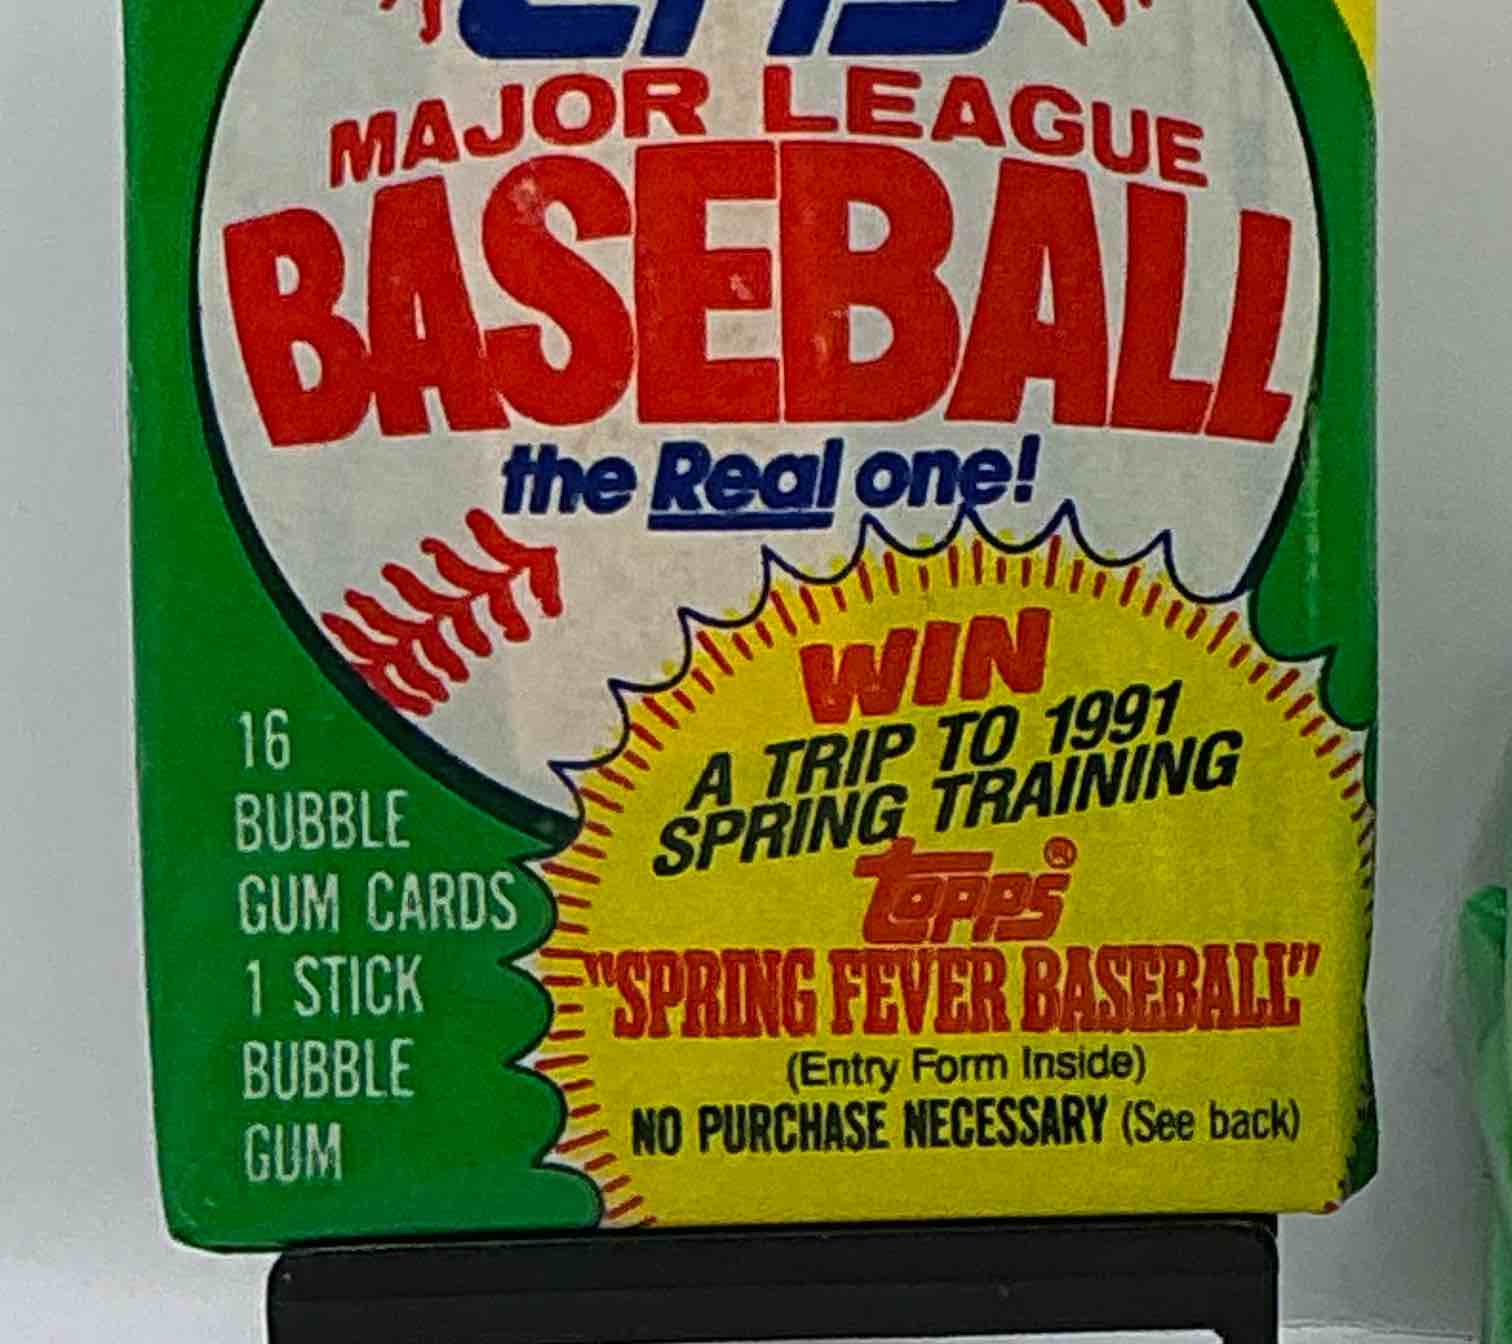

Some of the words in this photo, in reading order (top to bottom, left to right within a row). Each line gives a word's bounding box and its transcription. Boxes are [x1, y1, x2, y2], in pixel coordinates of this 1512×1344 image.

[330, 67, 710, 188] MAJOR
[762, 67, 1208, 188] LEAGUE
[222, 139, 1293, 447] BASEBALL
[502, 443, 637, 514] the
[648, 438, 844, 529] Real
[855, 434, 1040, 507] one!
[800, 607, 1051, 724] WIN
[238, 708, 291, 770] 16
[686, 753, 732, 811] A
[765, 723, 916, 799] TRIP
[939, 705, 1020, 772] TO
[1045, 679, 1184, 749] 1991
[234, 789, 411, 852] BUBBLE
[653, 785, 908, 877] SPRING
[934, 729, 1244, 833] TRAINING
[238, 873, 341, 935] GUM
[367, 870, 518, 932] CARDS
[245, 959, 263, 1017] 1
[293, 955, 425, 1017] STICK
[581, 947, 815, 1038] "SPRING
[828, 945, 1011, 1036] FEVER
[1021, 942, 1321, 1034] BASEBALL"
[242, 1038, 416, 1100] BUBBLE
[787, 1051, 899, 1094] (Entry
[913, 1049, 1009, 1086] Form
[1022, 1044, 1147, 1086] Inside)
[245, 1122, 344, 1185] GUM
[631, 1107, 682, 1156] NO
[699, 1102, 888, 1154] PURCHASE
[903, 1094, 1110, 1150] NECESSARY
[1121, 1099, 1195, 1145] (See
[1210, 1097, 1301, 1142] back)
